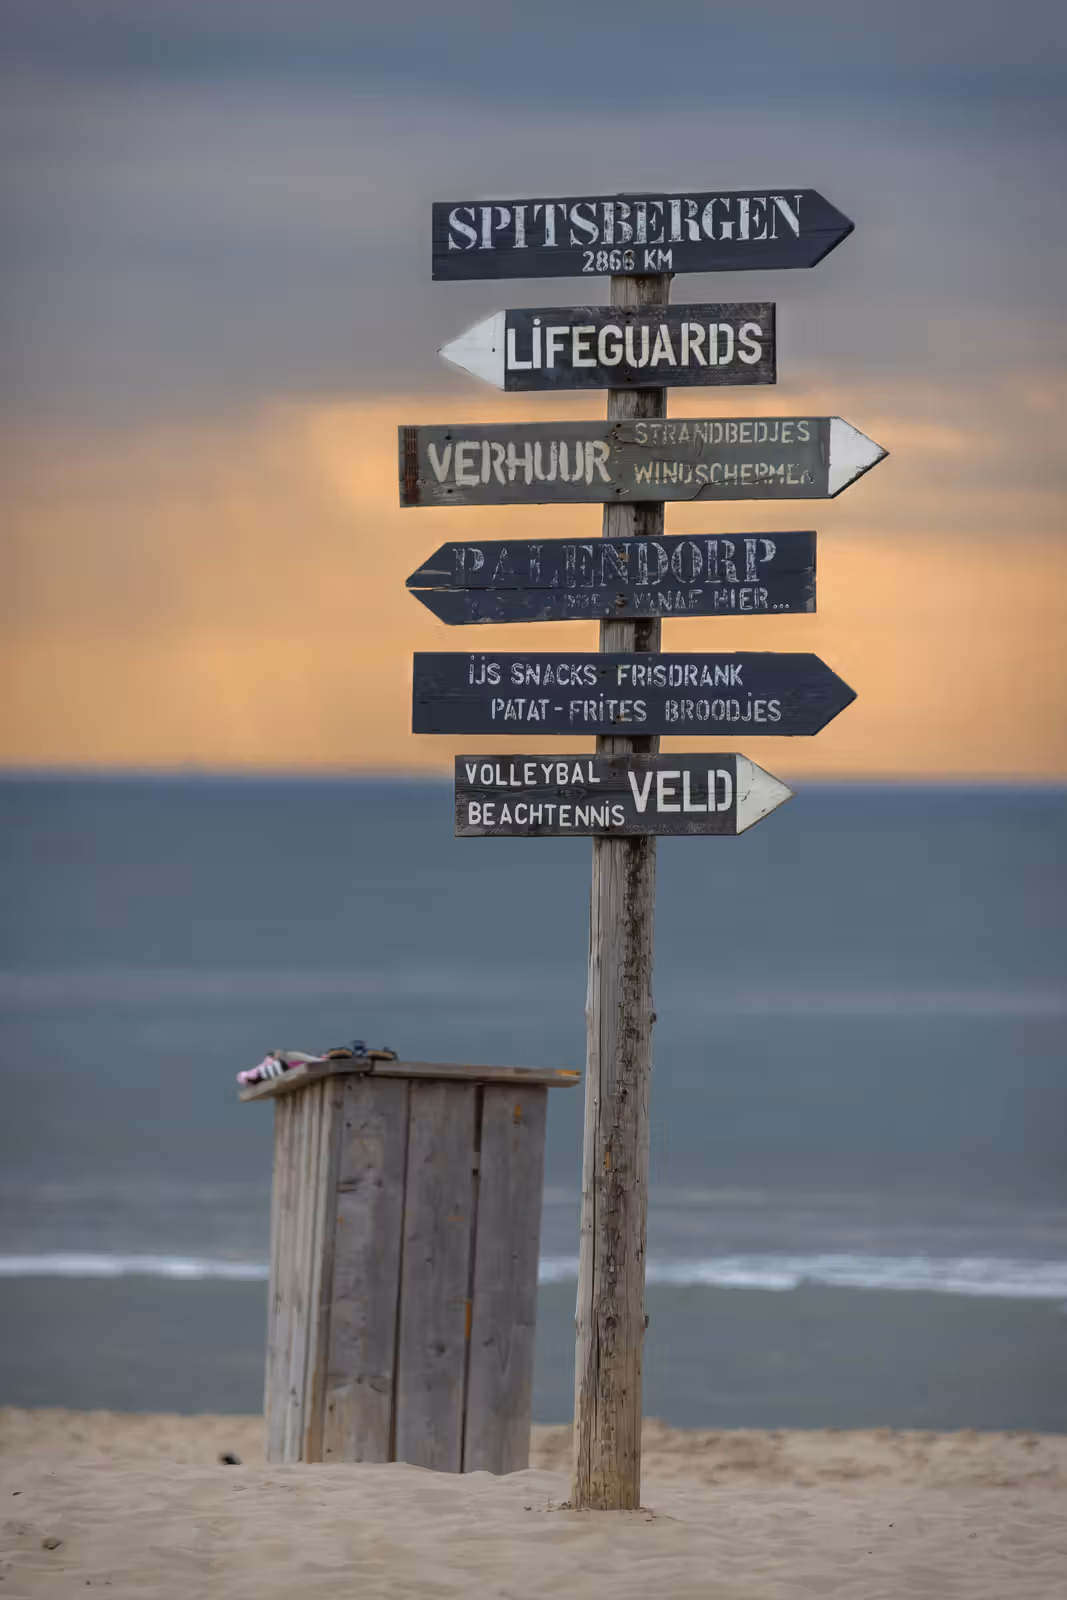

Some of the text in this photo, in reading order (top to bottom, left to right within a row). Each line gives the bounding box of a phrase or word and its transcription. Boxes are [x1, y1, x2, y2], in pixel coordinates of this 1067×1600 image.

[448, 194, 803, 250] SPITSBERGEN
[644, 248, 673, 270] KM
[634, 420, 811, 444] STRANDBEDJES
[427, 440, 612, 486] VERHUUR
[511, 663, 598, 686] SNACKS
[465, 761, 600, 786] VOLLEYBAL
[628, 769, 733, 813] VELD
